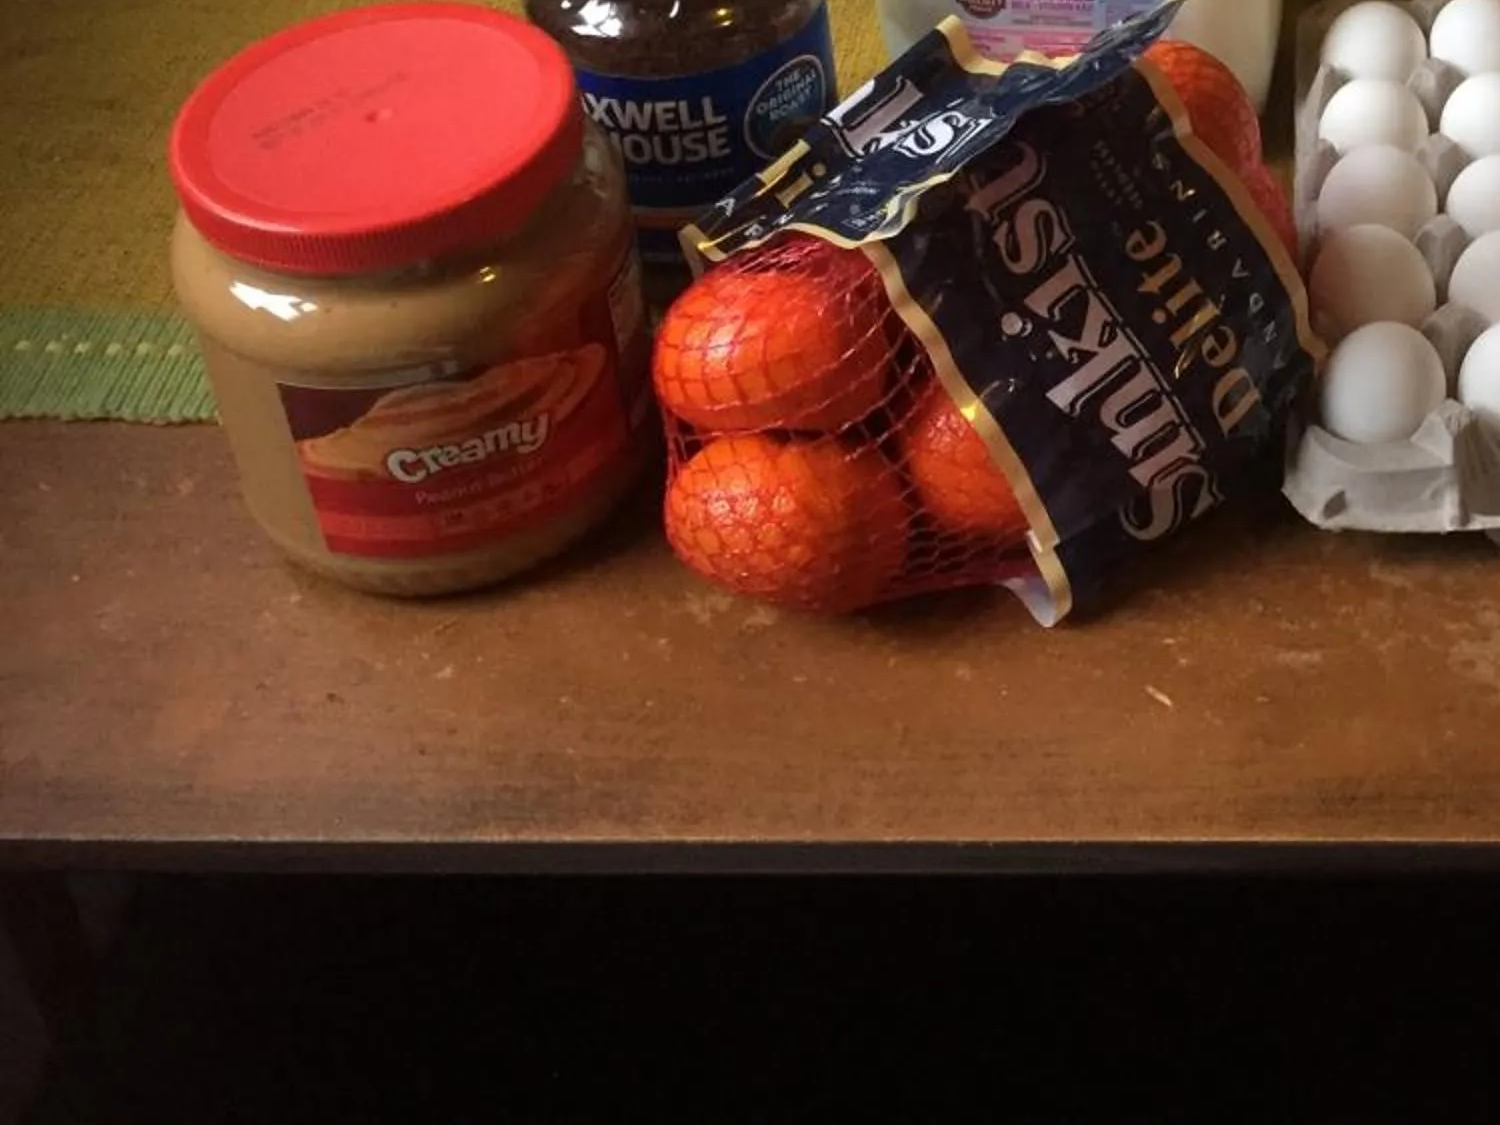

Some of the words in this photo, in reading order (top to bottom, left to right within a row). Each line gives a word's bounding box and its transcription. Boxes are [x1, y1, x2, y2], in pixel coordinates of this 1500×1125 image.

[581, 92, 728, 132] XWELL
[612, 126, 731, 165] OUSE
[966, 139, 1224, 540] Sunkist
[1125, 220, 1260, 437] Delite
[1151, 152, 1294, 399] ANDARINS
[387, 412, 549, 483] Creamy
